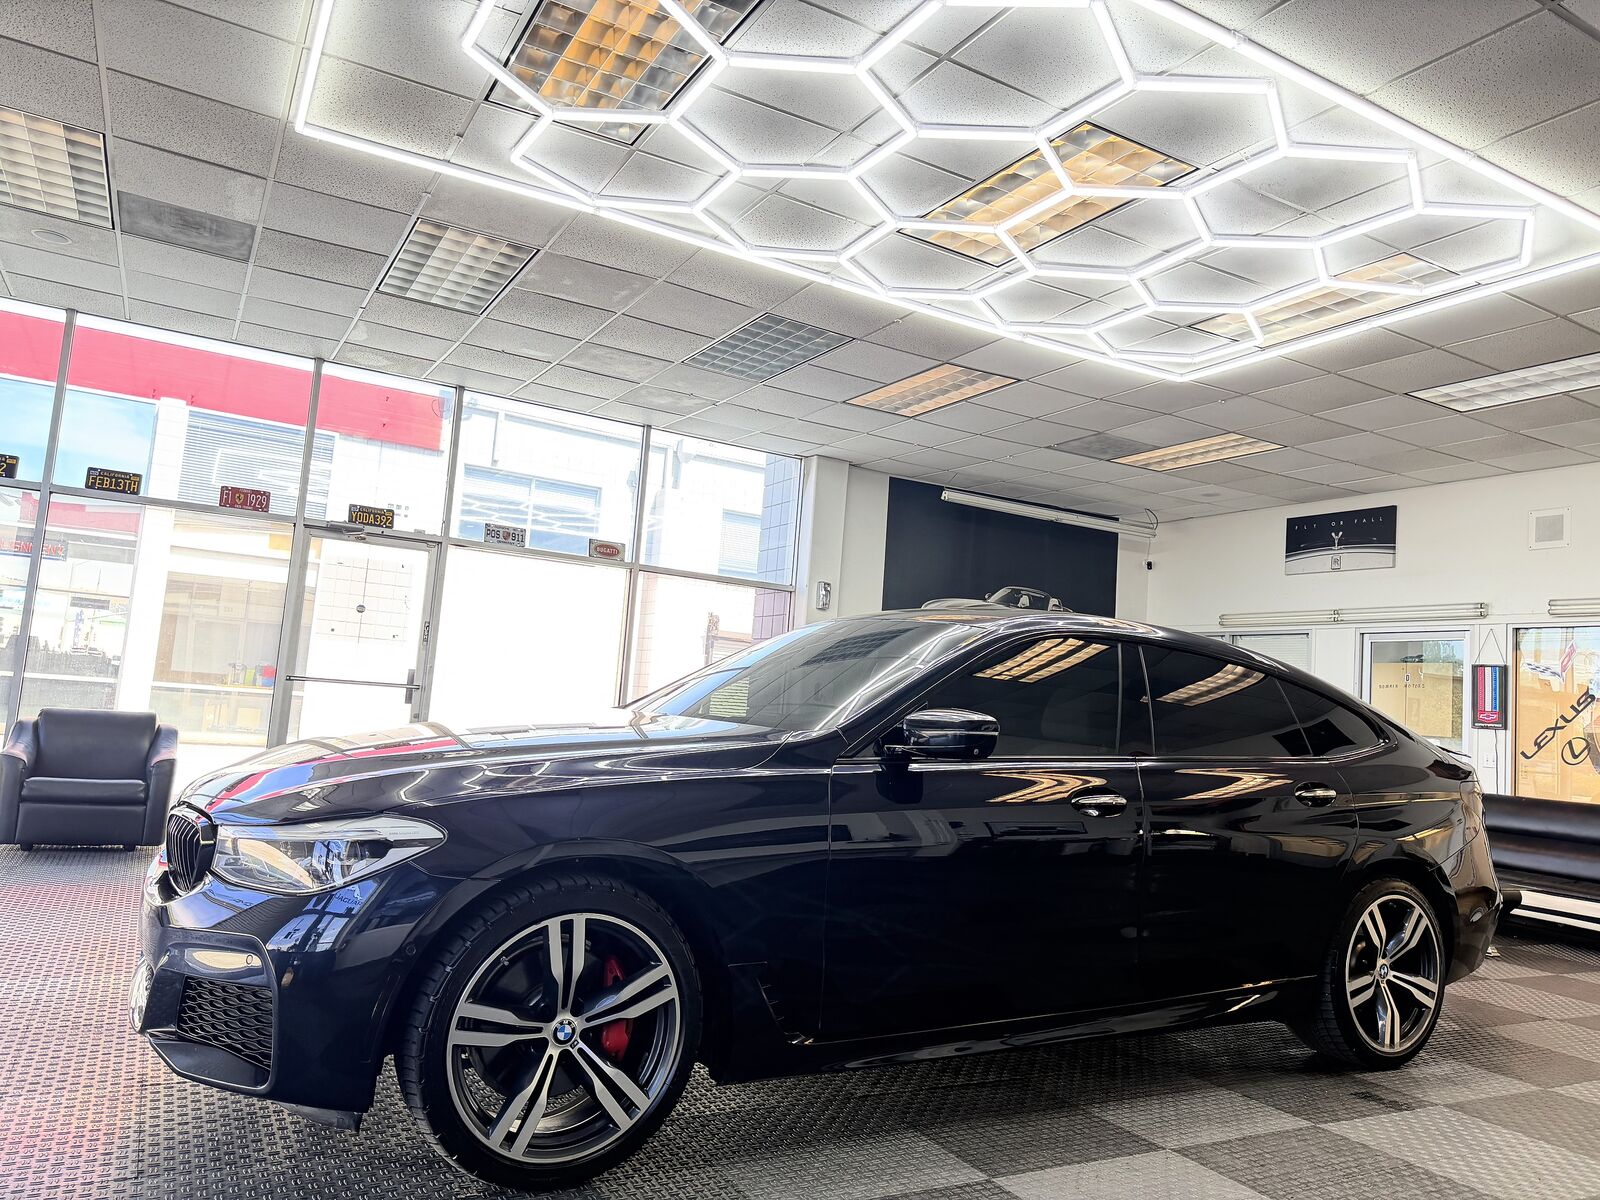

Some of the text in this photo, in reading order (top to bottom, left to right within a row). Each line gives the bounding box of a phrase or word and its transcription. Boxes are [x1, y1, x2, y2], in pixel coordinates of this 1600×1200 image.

[88, 475, 139, 492] FEB13TH
[247, 493, 267, 508] 1929
[351, 511, 393, 527] YODA392
[511, 532, 525, 543] 911
[596, 546, 619, 555] BUGATTI
[1520, 685, 1597, 760] LEXUS
